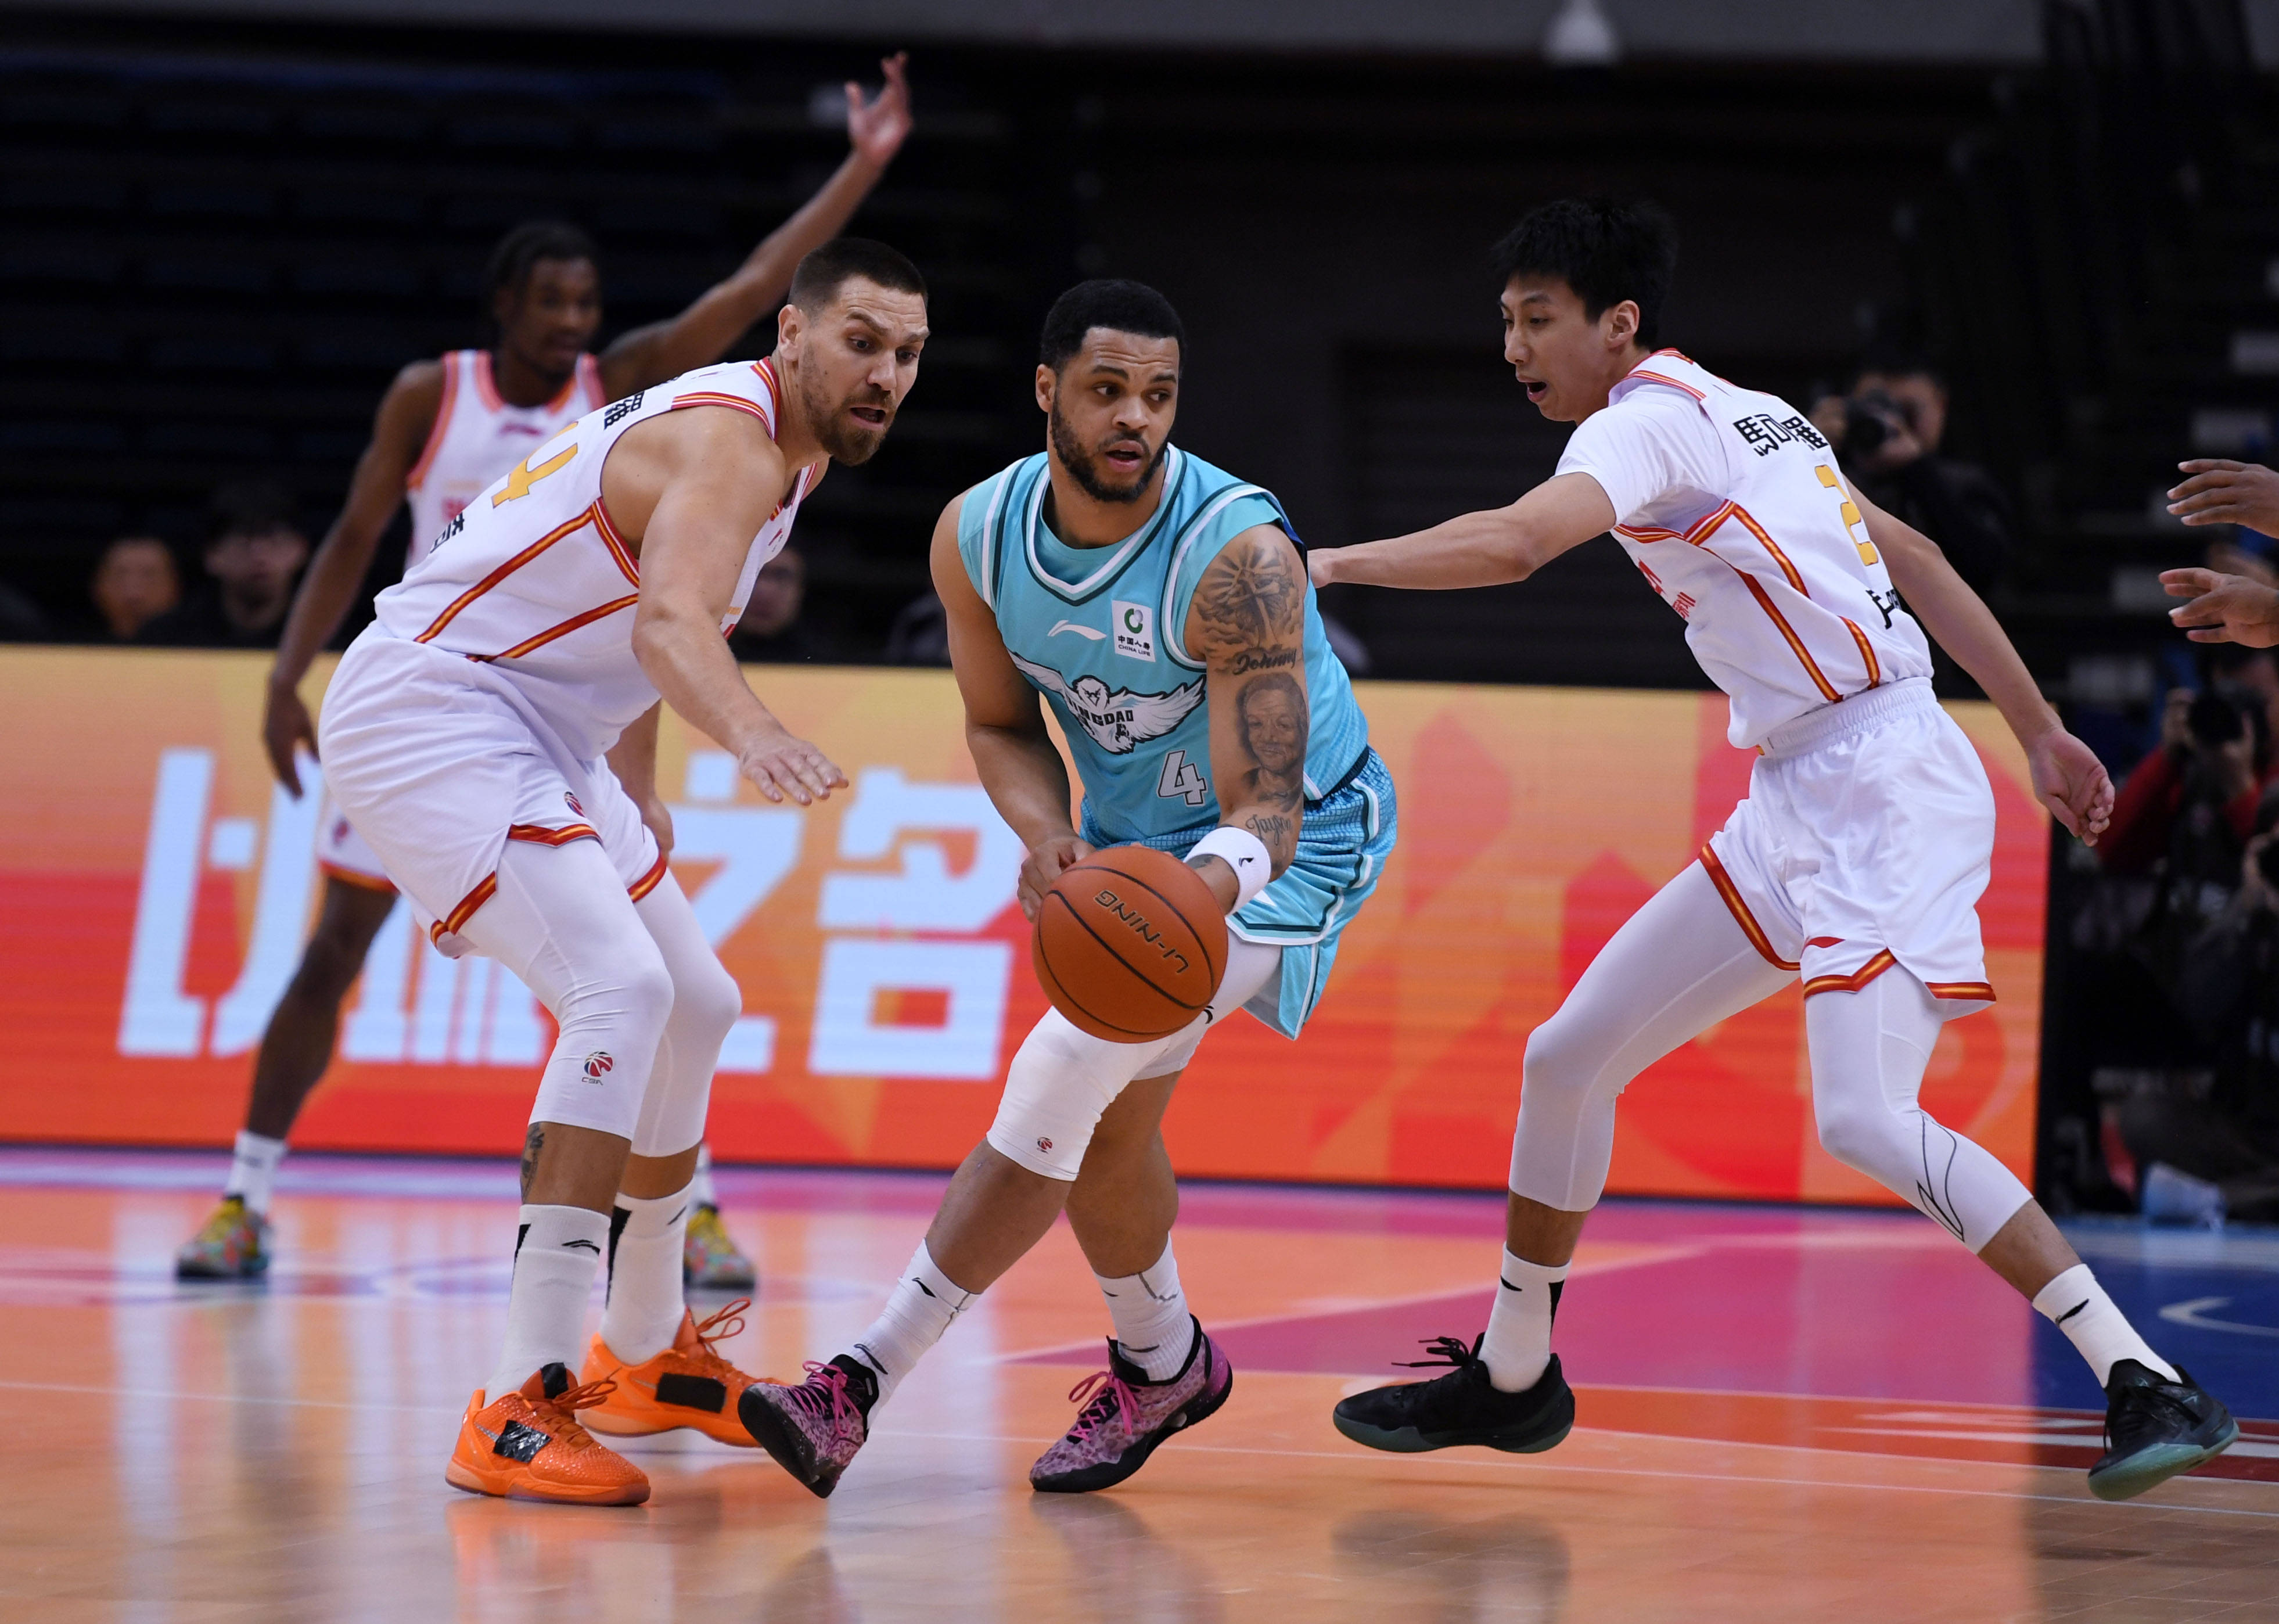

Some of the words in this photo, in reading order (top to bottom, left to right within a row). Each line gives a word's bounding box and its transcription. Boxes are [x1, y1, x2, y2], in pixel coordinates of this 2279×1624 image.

[1814, 464, 1879, 567] 2
[1117, 635, 1151, 651] 中国人寿
[1118, 644, 1137, 653] CHINA
[1156, 748, 1208, 807] 4
[1093, 889, 1189, 975] LI-NING
